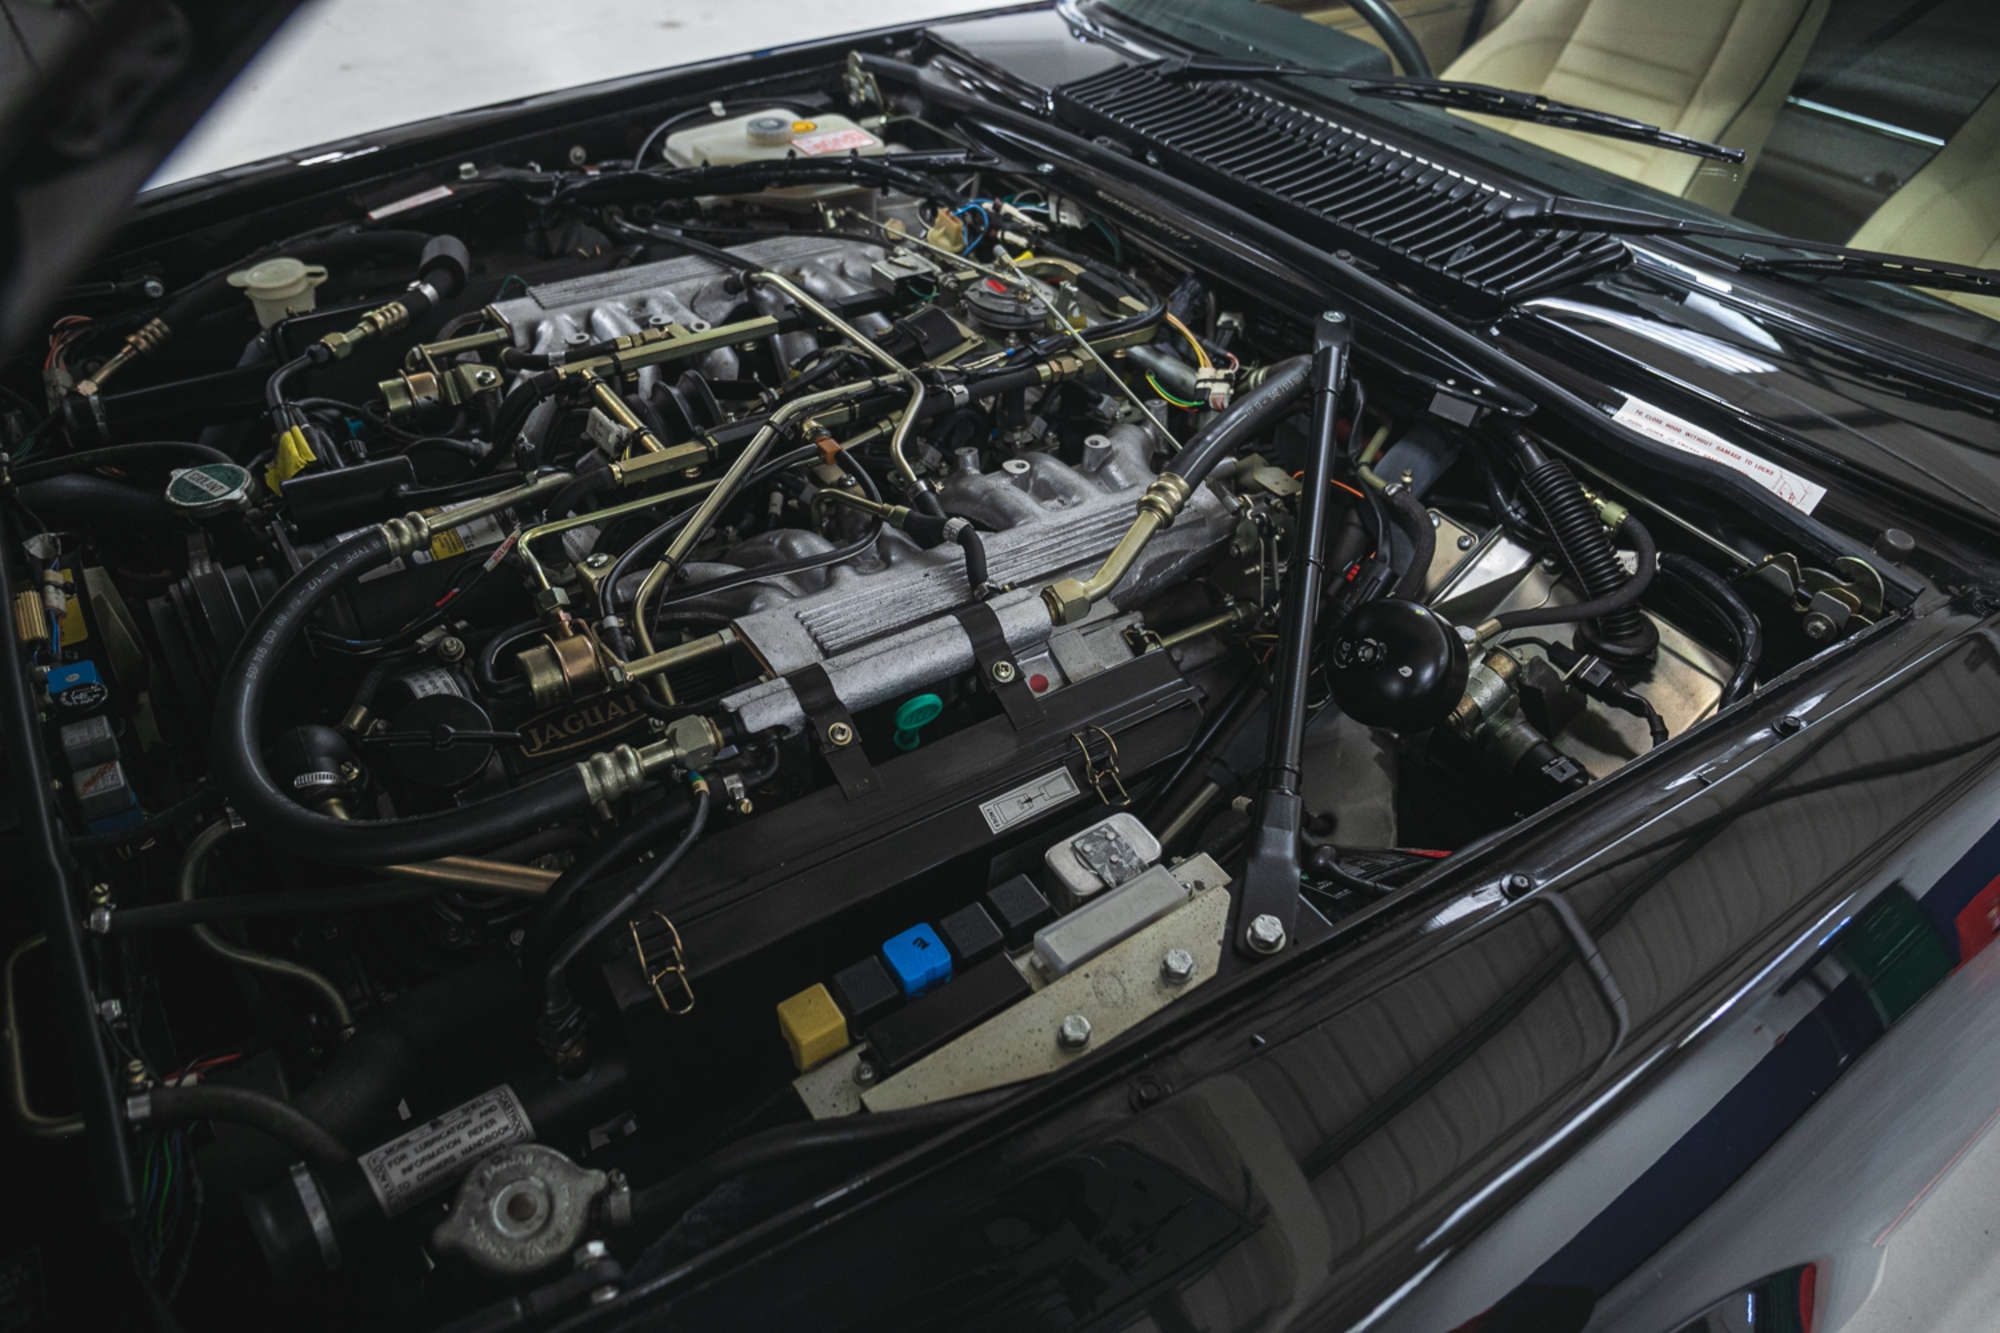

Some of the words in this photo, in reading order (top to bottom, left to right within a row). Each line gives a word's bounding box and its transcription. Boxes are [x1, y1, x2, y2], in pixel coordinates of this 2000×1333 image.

[388, 1153, 408, 1169] FOR
[414, 1118, 473, 1152] LUBRICATION
[479, 1104, 498, 1118] AND
[401, 1138, 462, 1175] INFORMATION
[468, 1118, 497, 1137] REFER
[417, 1155, 457, 1181] OWNERS
[461, 1125, 510, 1155] HANDBOOK
